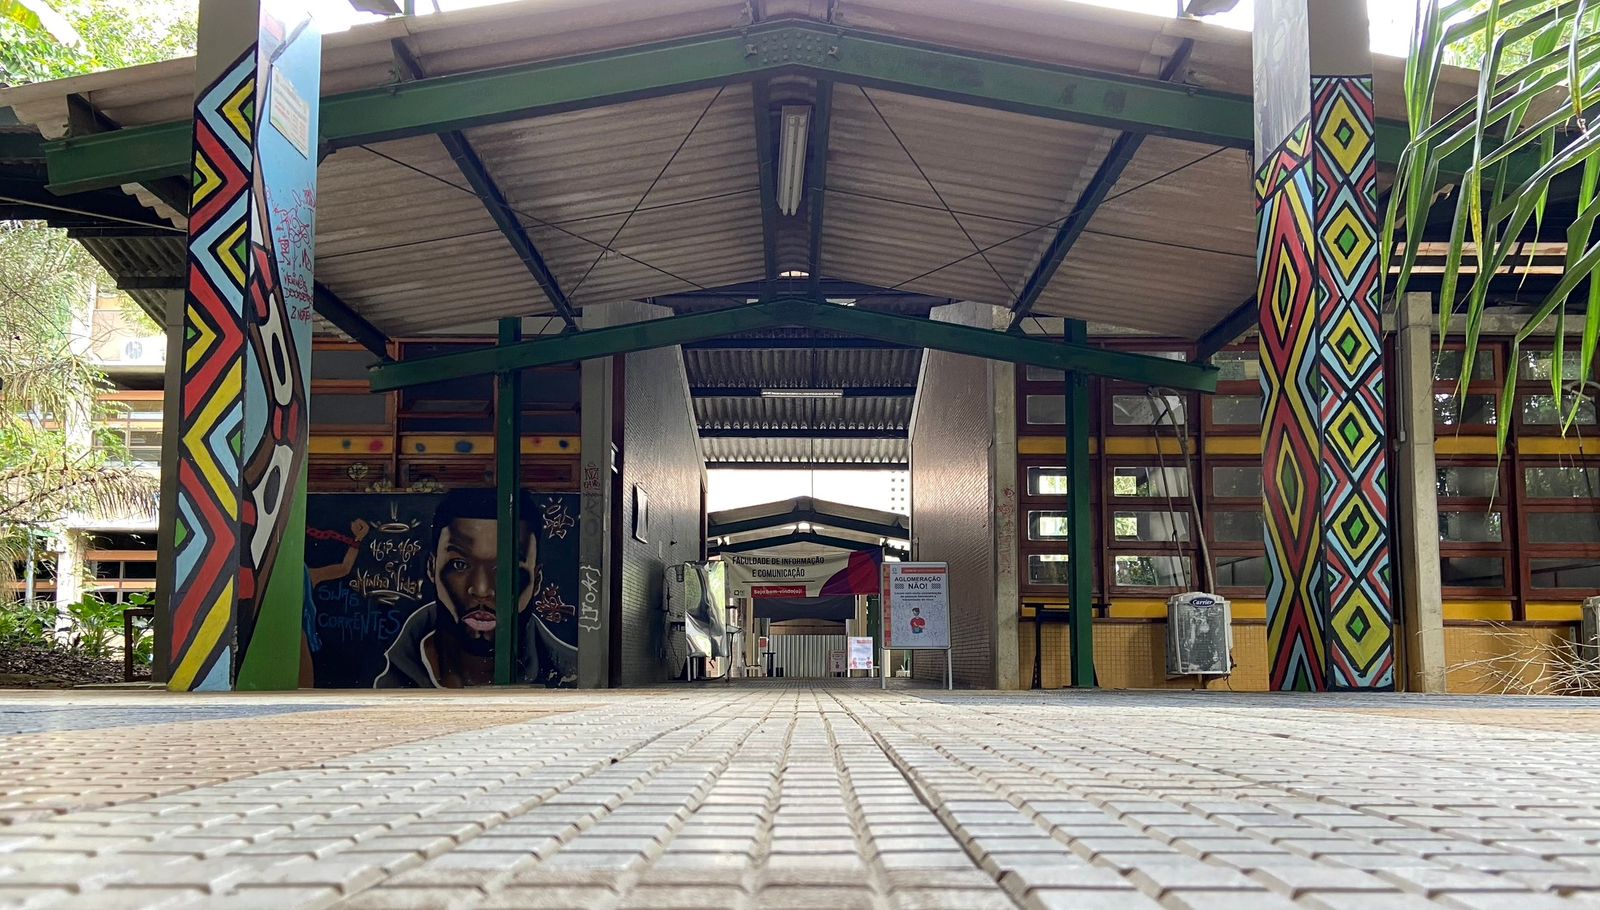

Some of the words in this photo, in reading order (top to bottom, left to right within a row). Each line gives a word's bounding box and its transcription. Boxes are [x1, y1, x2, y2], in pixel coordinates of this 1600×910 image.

[732, 556, 769, 566] FACULDADE
[771, 557, 780, 565] DE
[781, 556, 825, 566] INFORMAÇÃO
[752, 569, 757, 578] E
[758, 567, 805, 578] COMUNICAÇÃO
